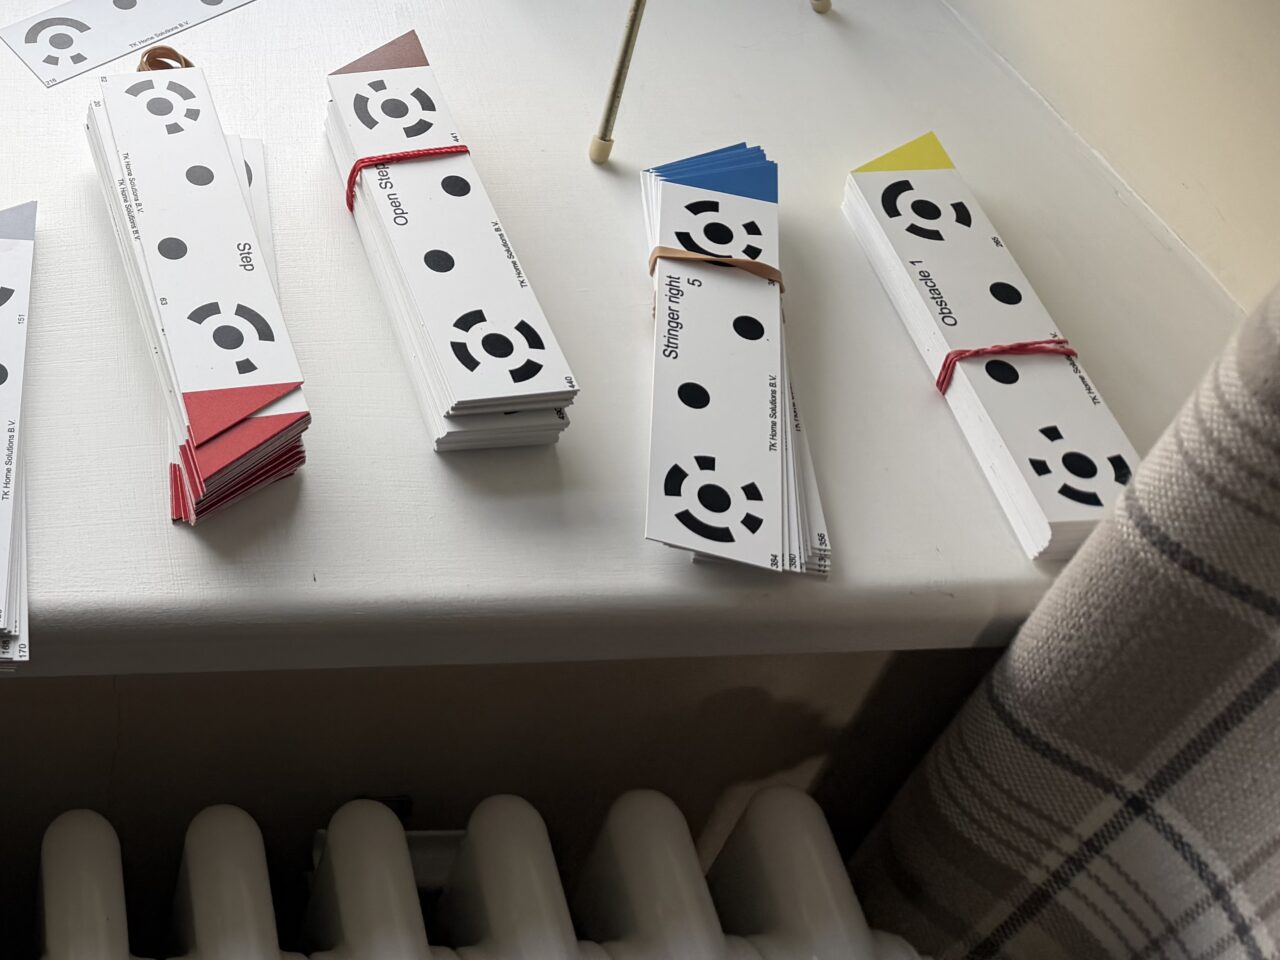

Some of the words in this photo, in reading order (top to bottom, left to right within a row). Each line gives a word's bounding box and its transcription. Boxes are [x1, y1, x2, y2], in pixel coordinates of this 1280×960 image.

[139, 35, 155, 45] Home
[154, 25, 179, 38] Solutions
[124, 161, 133, 176] Home
[129, 178, 139, 202] Solutions
[374, 163, 394, 190] Step
[119, 187, 129, 203] Home
[124, 204, 137, 229] Solutions
[386, 192, 409, 227] Open
[498, 232, 515, 260] Solutions
[236, 242, 255, 272] Step
[511, 260, 524, 279] Home
[518, 279, 528, 289] TK
[664, 275, 685, 305] right
[686, 277, 703, 288] 5
[918, 270, 958, 327] Obstacle
[17, 314, 25, 325] 151
[662, 306, 684, 360] Stringer
[564, 376, 576, 389] 440
[768, 374, 778, 388] B.V.
[1078, 374, 1095, 395] Home
[768, 388, 778, 420] Solutions
[1089, 394, 1102, 406] TK
[7, 419, 16, 433] B.V.
[768, 420, 778, 440] Home
[4, 434, 15, 466] Solutions
[768, 440, 778, 452] TK
[3, 467, 12, 489] Home
[1, 490, 10, 501] TK
[18, 643, 28, 658] 170
